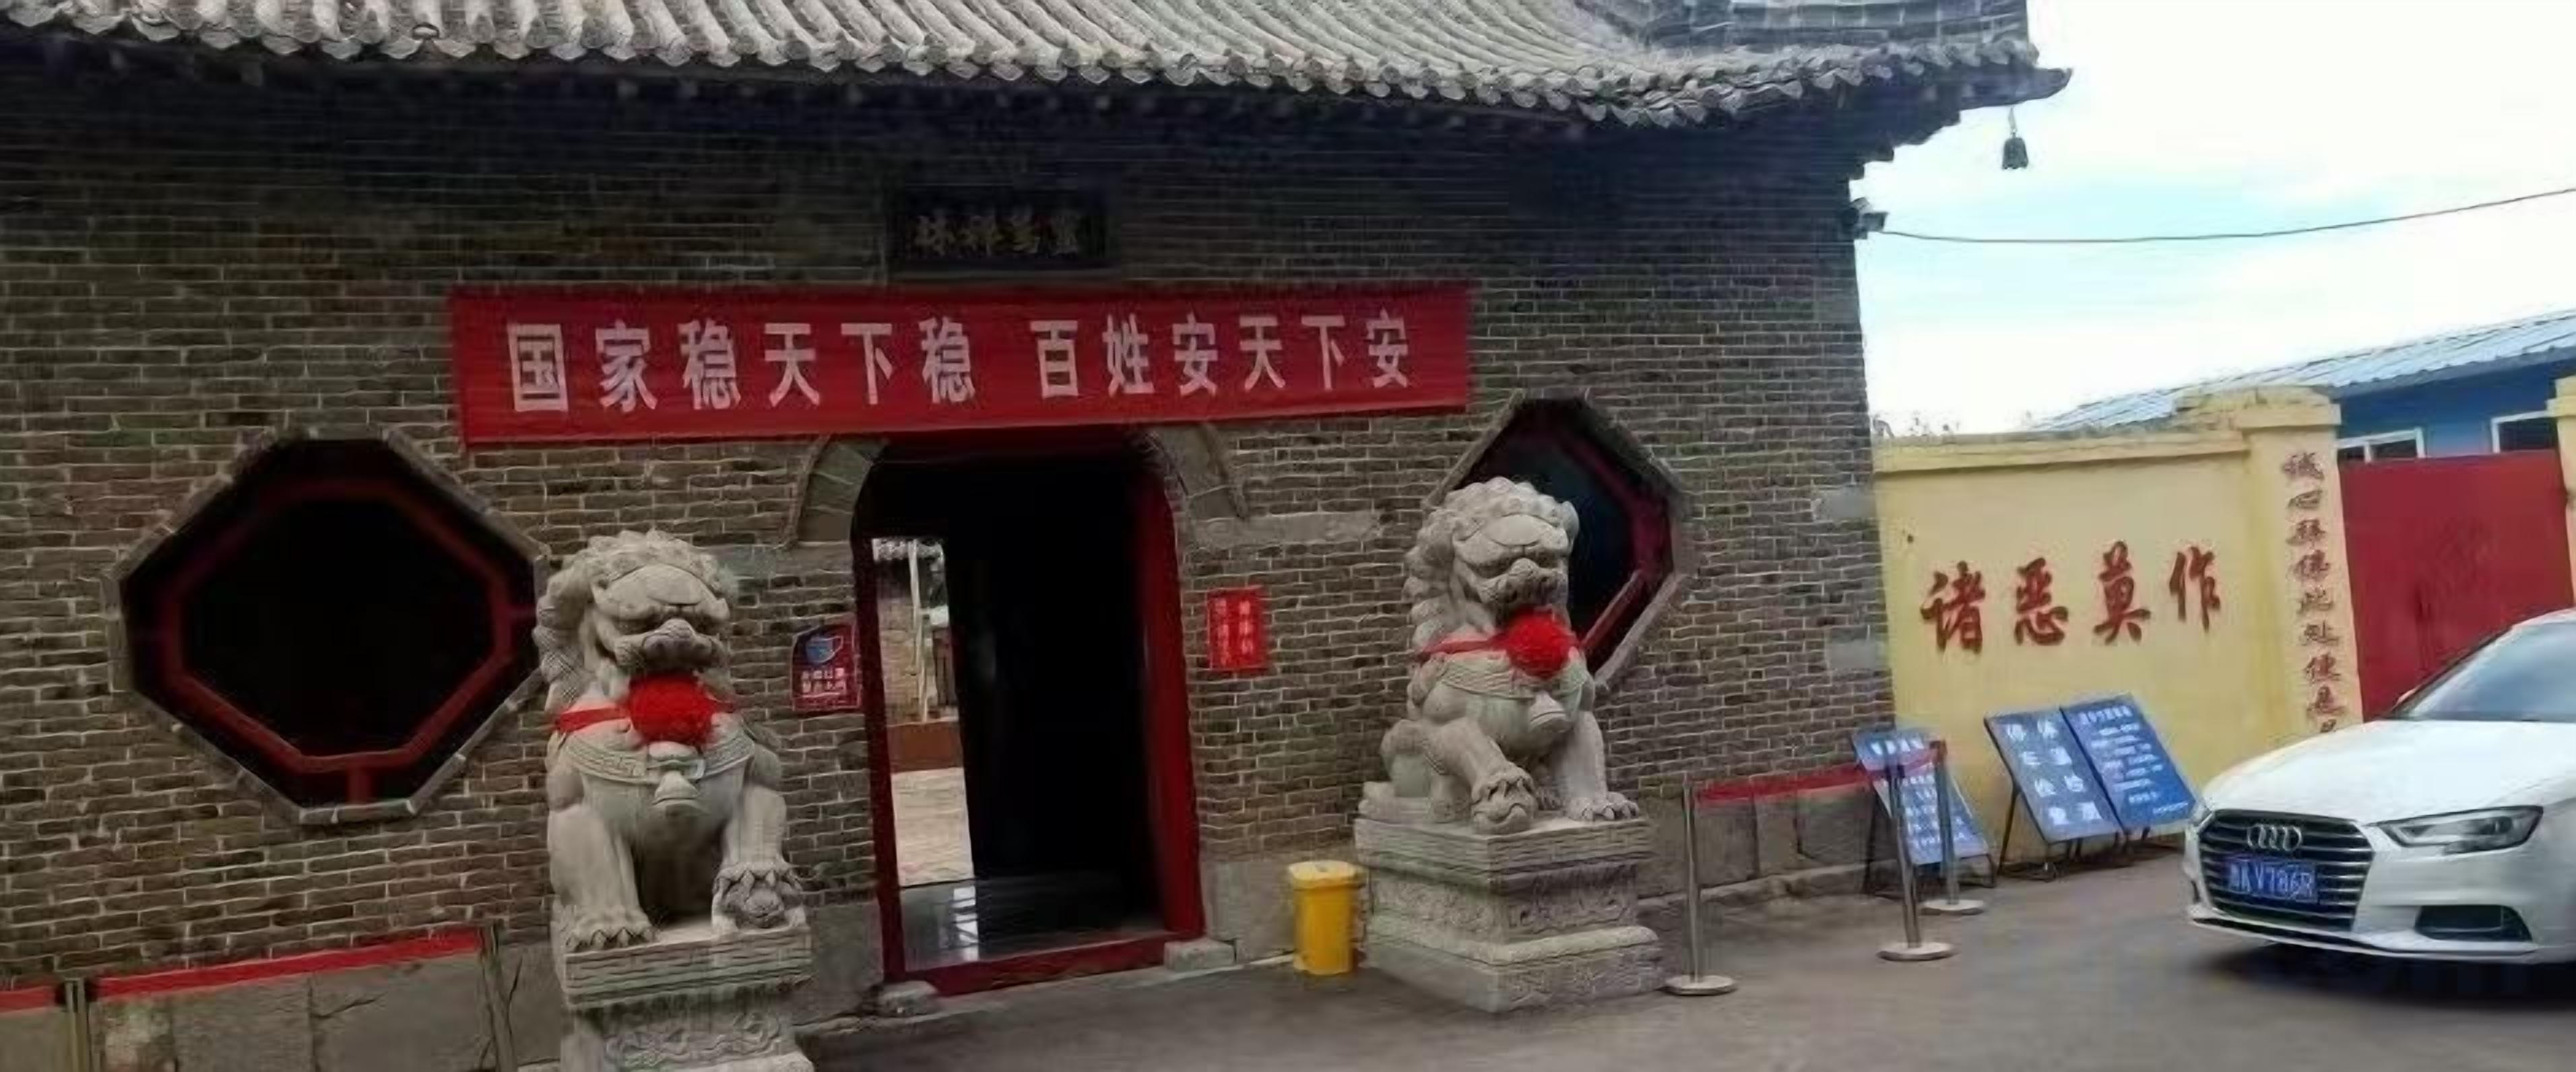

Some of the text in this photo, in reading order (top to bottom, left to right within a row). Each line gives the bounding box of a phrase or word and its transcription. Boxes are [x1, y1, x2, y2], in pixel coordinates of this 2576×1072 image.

[507, 309, 1409, 412] 国家稳天下稳 百姓安天下安
[1921, 541, 2221, 653] 诸恶莫作
